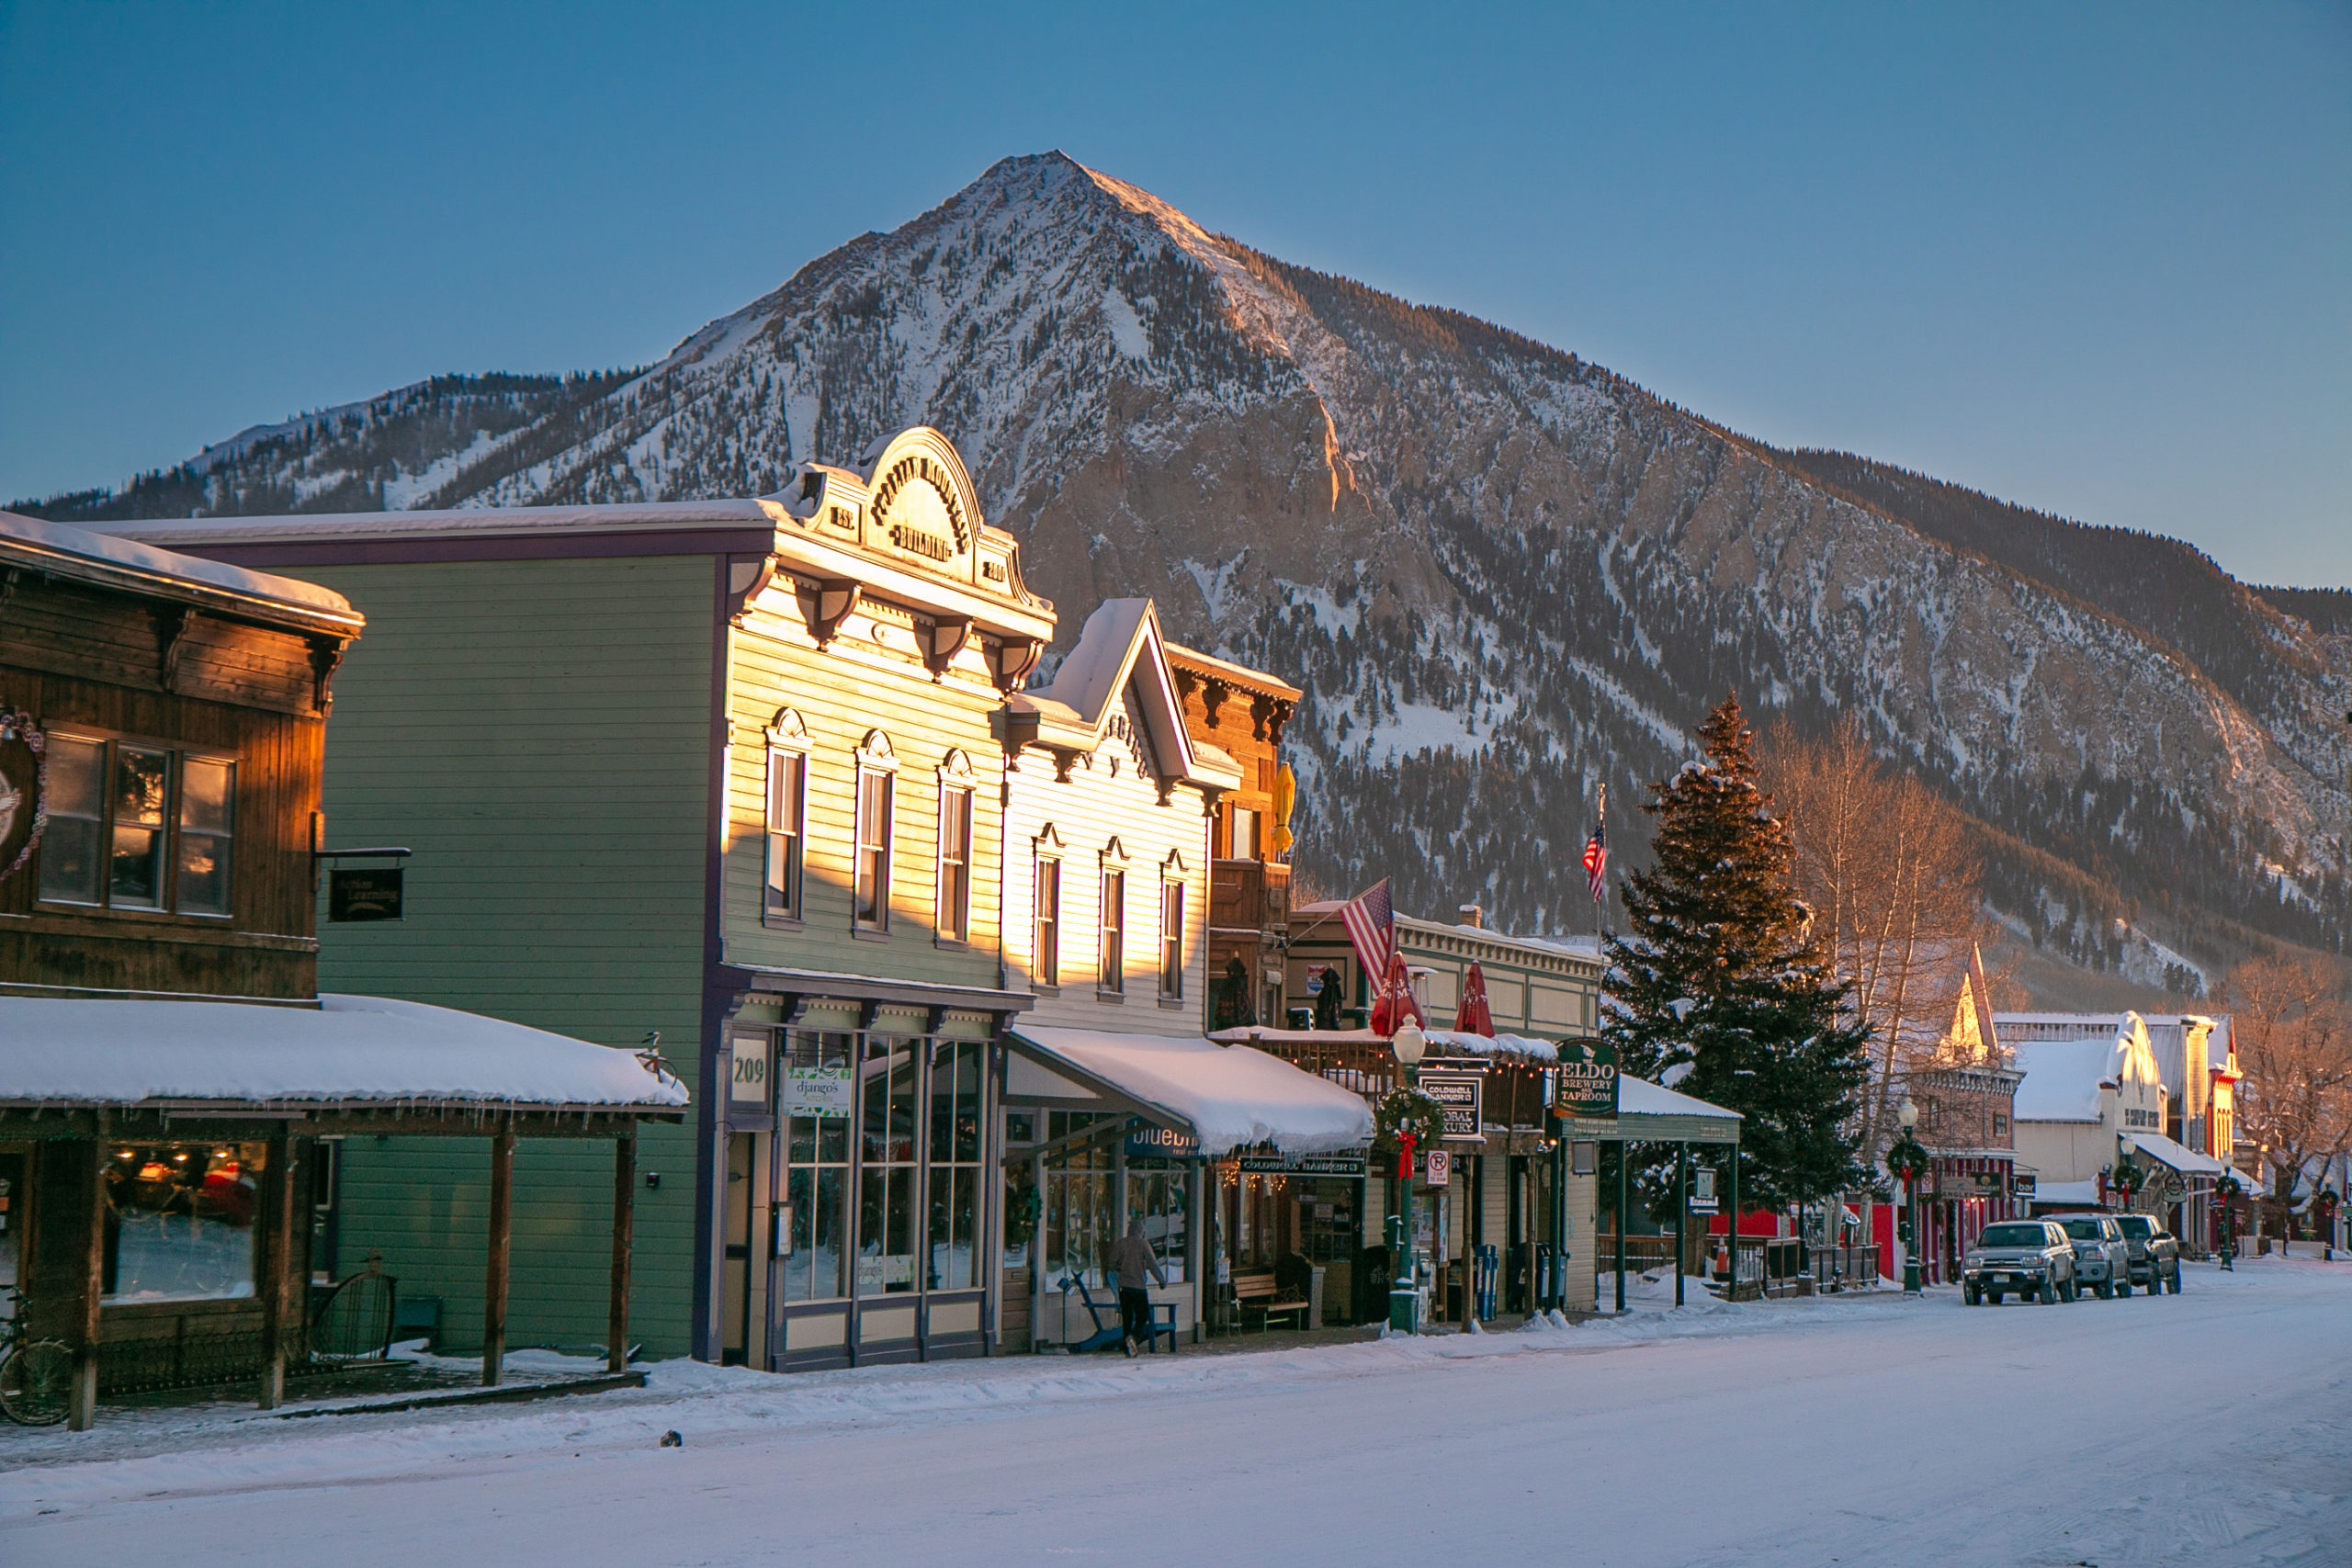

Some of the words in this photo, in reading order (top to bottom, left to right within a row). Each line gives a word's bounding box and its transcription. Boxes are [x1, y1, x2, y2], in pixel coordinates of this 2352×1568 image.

[894, 525, 950, 562] BUILDING
[734, 1057, 764, 1083] 209
[1561, 1063, 1614, 1079] ELDO
[797, 1080, 839, 1097] django's
[1562, 1078, 1612, 1089] BREWERY
[1428, 1086, 1473, 1094] COLDWELL
[1562, 1091, 1611, 1101] TAPROOM
[1443, 1111, 1473, 1122] OBAL
[1442, 1122, 1474, 1133] XURY
[1303, 1162, 1348, 1171] BANKER
